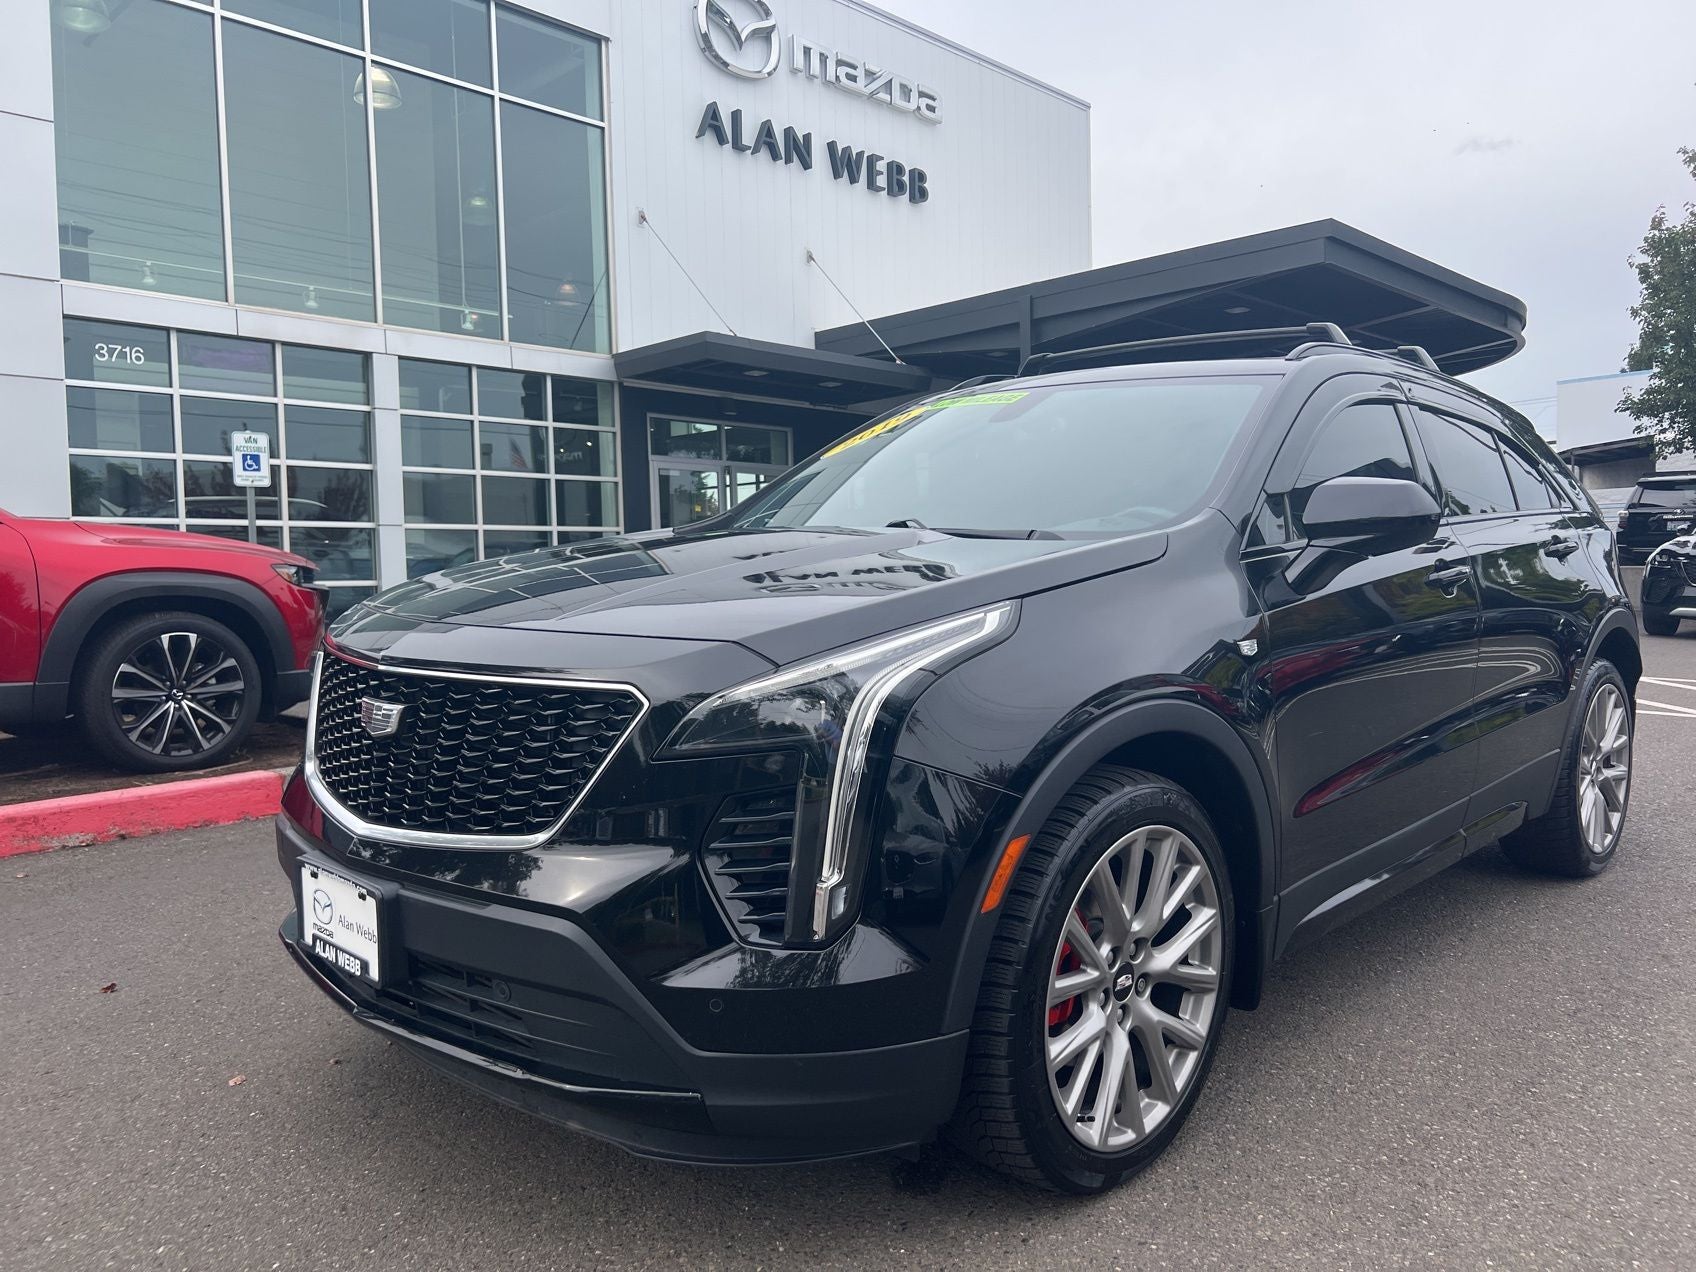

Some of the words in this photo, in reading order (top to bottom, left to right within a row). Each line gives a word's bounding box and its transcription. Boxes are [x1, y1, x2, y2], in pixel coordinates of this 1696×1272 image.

[695, 101, 813, 171] ALAN
[826, 139, 929, 205] WEBB
[94, 343, 145, 366] 3716
[235, 444, 267, 453] ACCESSIBLE
[243, 437, 258, 445] VAN
[338, 914, 355, 932] Alan
[356, 923, 377, 944] Webb
[315, 940, 336, 962] ALAN
[337, 949, 361, 976] WEBB
